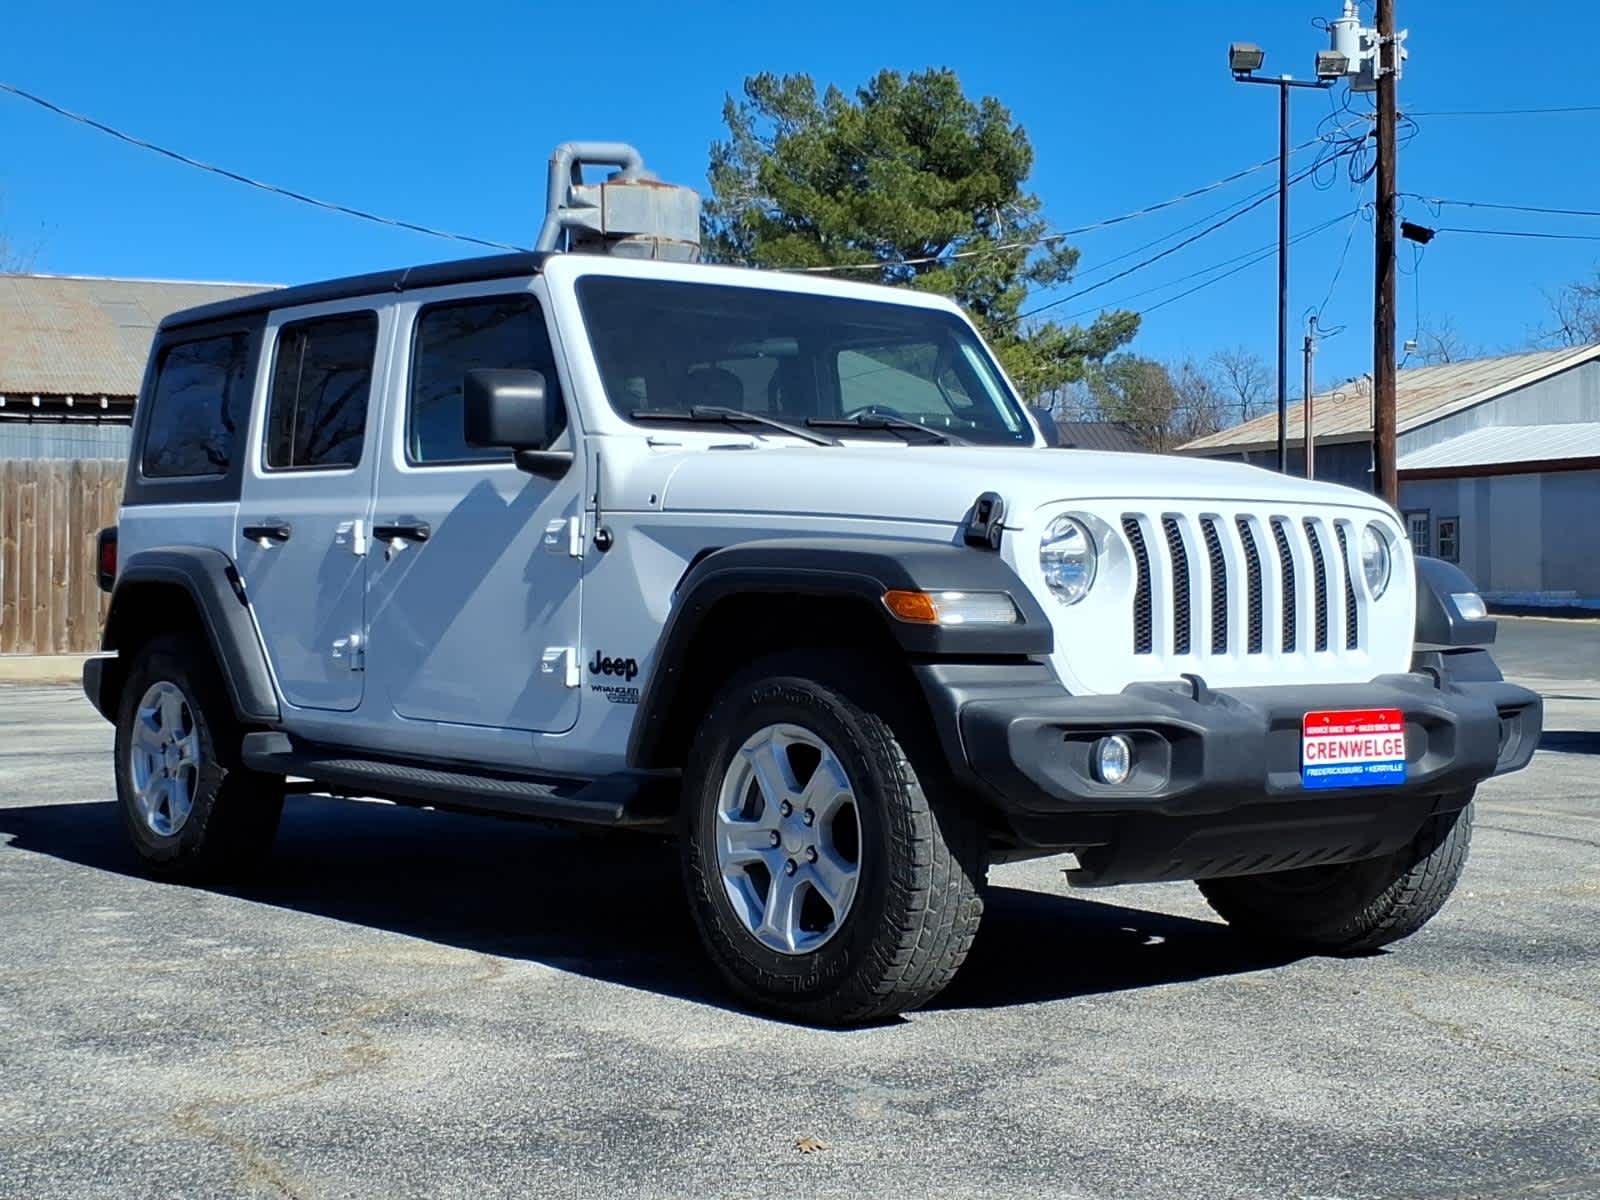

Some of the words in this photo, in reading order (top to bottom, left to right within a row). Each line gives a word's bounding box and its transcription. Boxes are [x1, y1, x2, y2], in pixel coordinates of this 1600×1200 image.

[588, 649, 638, 682] Jeep
[591, 685, 639, 694] WRANGLER
[1306, 739, 1403, 759] CRENWELGE
